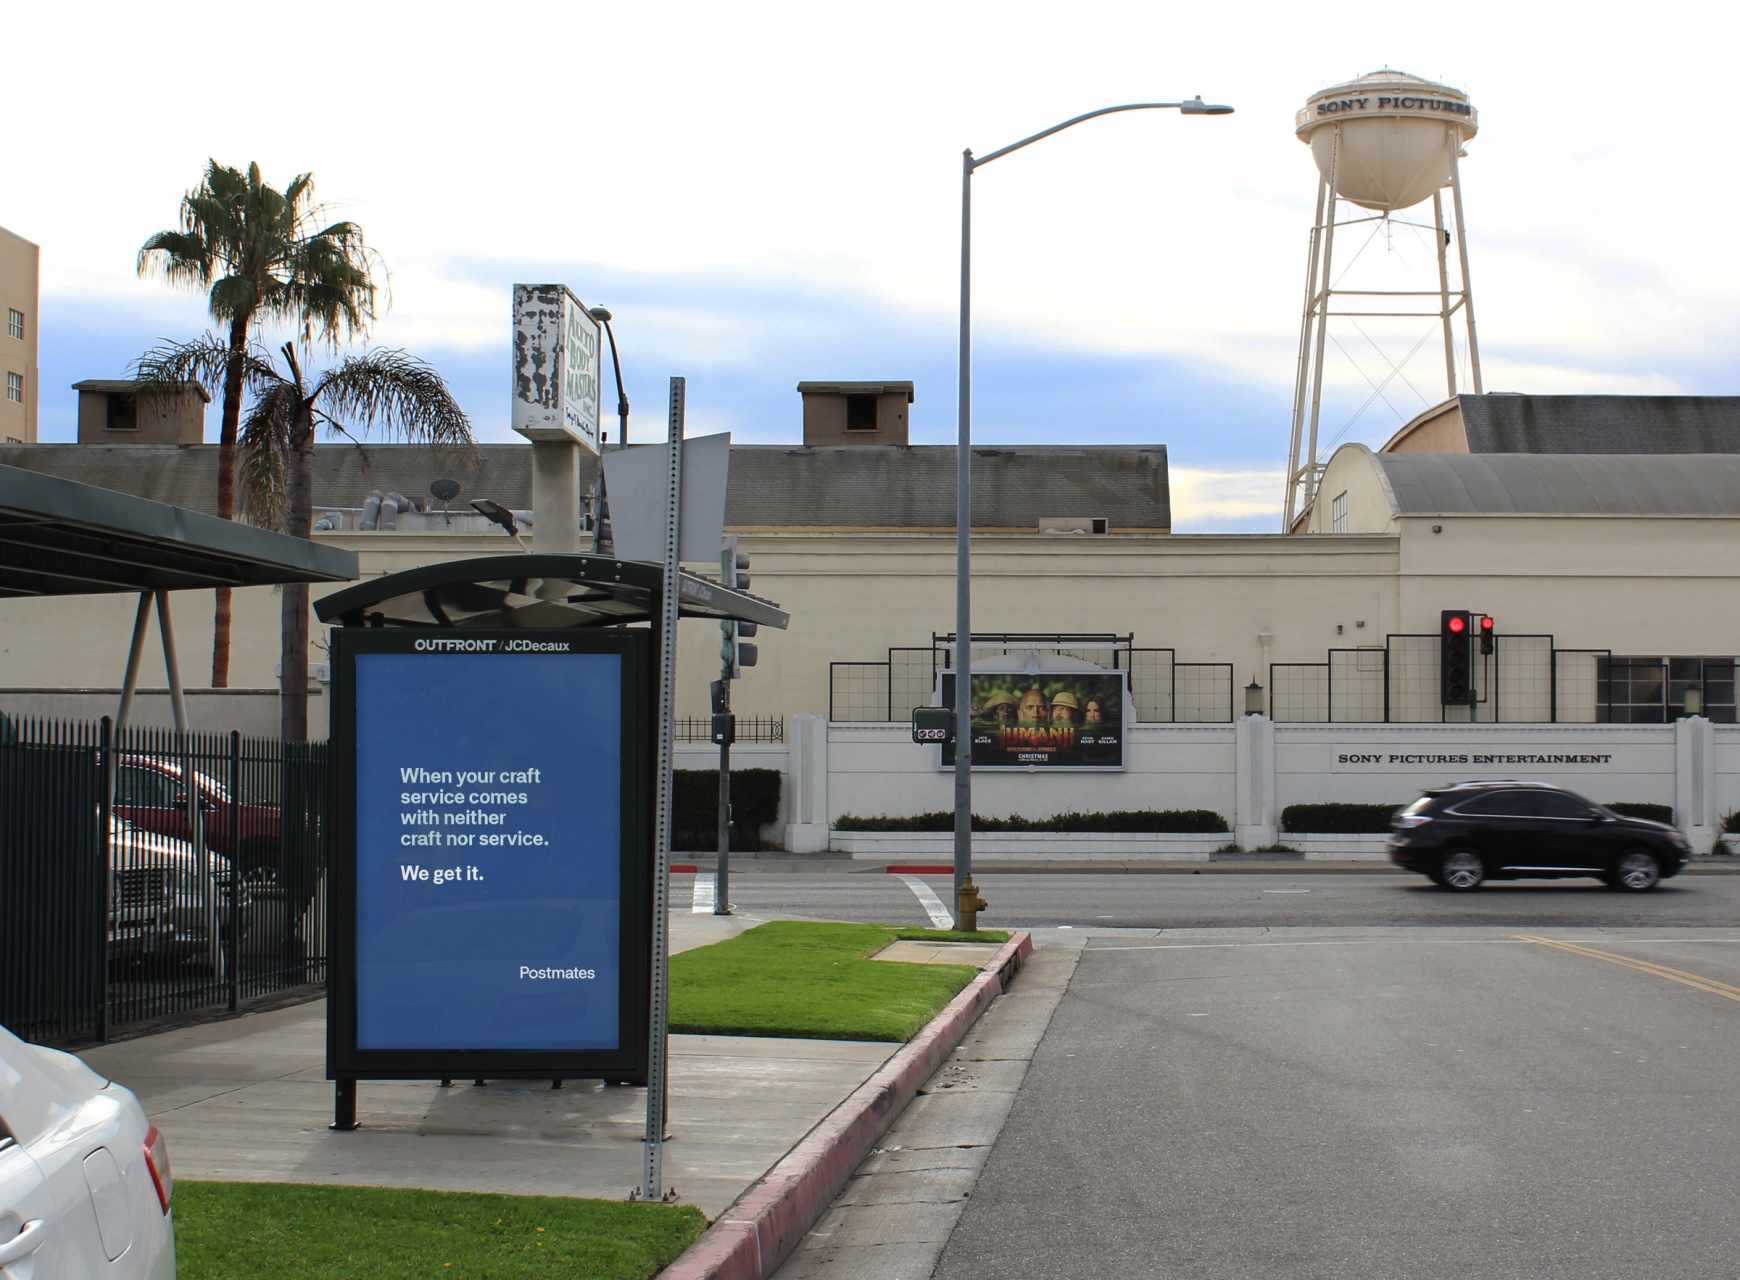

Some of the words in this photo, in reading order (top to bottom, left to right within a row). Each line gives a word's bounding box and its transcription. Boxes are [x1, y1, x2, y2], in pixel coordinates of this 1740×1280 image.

[1317, 97, 1369, 116] SONY
[567, 303, 595, 359] AUTO
[569, 337, 590, 371] BODY
[414, 639, 497, 651] OUTFRONT
[505, 639, 570, 651] JCDecaux
[1338, 754, 1383, 764] SONY
[1388, 754, 1468, 764] PICTURES
[1473, 754, 1612, 764] ENTERTAINMENT
[400, 767, 452, 784] When
[456, 771, 496, 788] your
[499, 767, 541, 784] craft
[400, 789, 465, 804] service
[469, 792, 528, 804] comes
[400, 809, 440, 825] with
[444, 809, 506, 825] neither
[400, 830, 442, 846] craft
[446, 833, 475, 846] nor
[479, 830, 549, 846] service.
[400, 865, 429, 881] We
[433, 866, 462, 885] get
[466, 865, 484, 881] it.
[520, 965, 596, 980] Postmates
